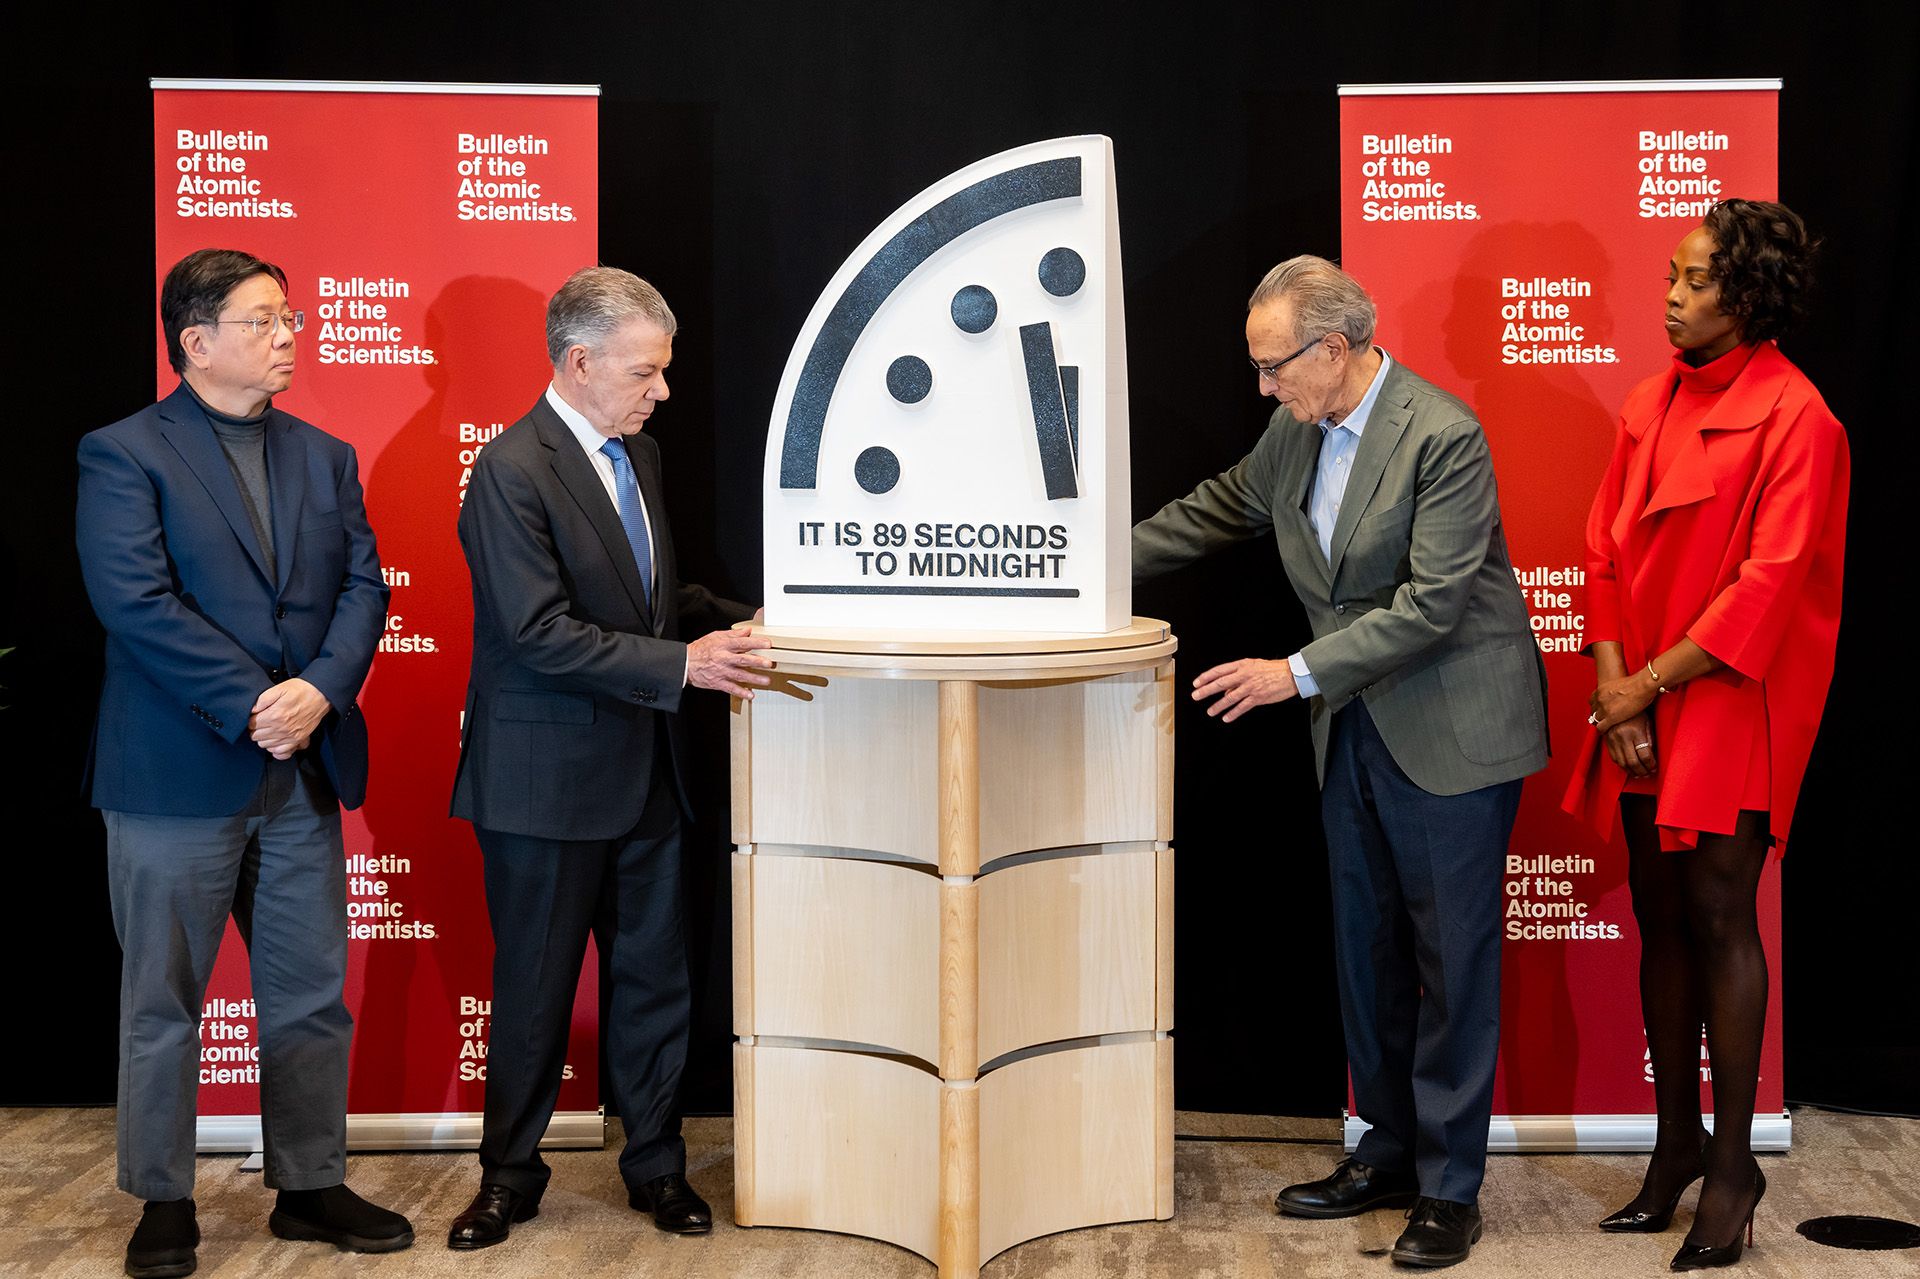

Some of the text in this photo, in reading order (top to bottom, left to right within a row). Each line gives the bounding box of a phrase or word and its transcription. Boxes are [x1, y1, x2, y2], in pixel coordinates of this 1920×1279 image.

[177, 130, 269, 151] Bulletin
[458, 133, 548, 154] Bulletin
[1362, 134, 1452, 155] Bulletin
[1639, 130, 1728, 151] Bulletin
[176, 151, 246, 173] of the
[457, 155, 526, 177] of the
[1362, 156, 1430, 177] of the
[1638, 152, 1707, 174] of the
[176, 174, 262, 195] Atomic
[457, 177, 541, 199] Atomic
[1362, 178, 1445, 199] Atomic
[1638, 174, 1722, 195] Atomic
[1638, 197, 1719, 218] Scient
[318, 277, 409, 298] Bulletin
[1501, 277, 1591, 298] Bulletin
[318, 299, 387, 320] of the
[1501, 299, 1569, 320] of the
[318, 321, 402, 342] Atomic
[1501, 321, 1584, 342] Atomic
[459, 423, 504, 444] Bull
[799, 522, 1068, 550] IT IS 89 SECONDS
[856, 551, 1066, 579] TO MIDNIGHT
[1533, 588, 1571, 608] the
[1529, 610, 1585, 631] omic
[345, 854, 411, 874] lletin
[1505, 854, 1595, 875] Bulletin
[349, 876, 388, 896] the
[1505, 876, 1573, 897] of the
[346, 898, 404, 918] omic
[1505, 898, 1588, 919] Atomic
[201, 998, 256, 1018] ulleti
[209, 1020, 249, 1040] the
[459, 1017, 485, 1038] of
[200, 1042, 260, 1062] tomic
[199, 1064, 261, 1084] cienti
